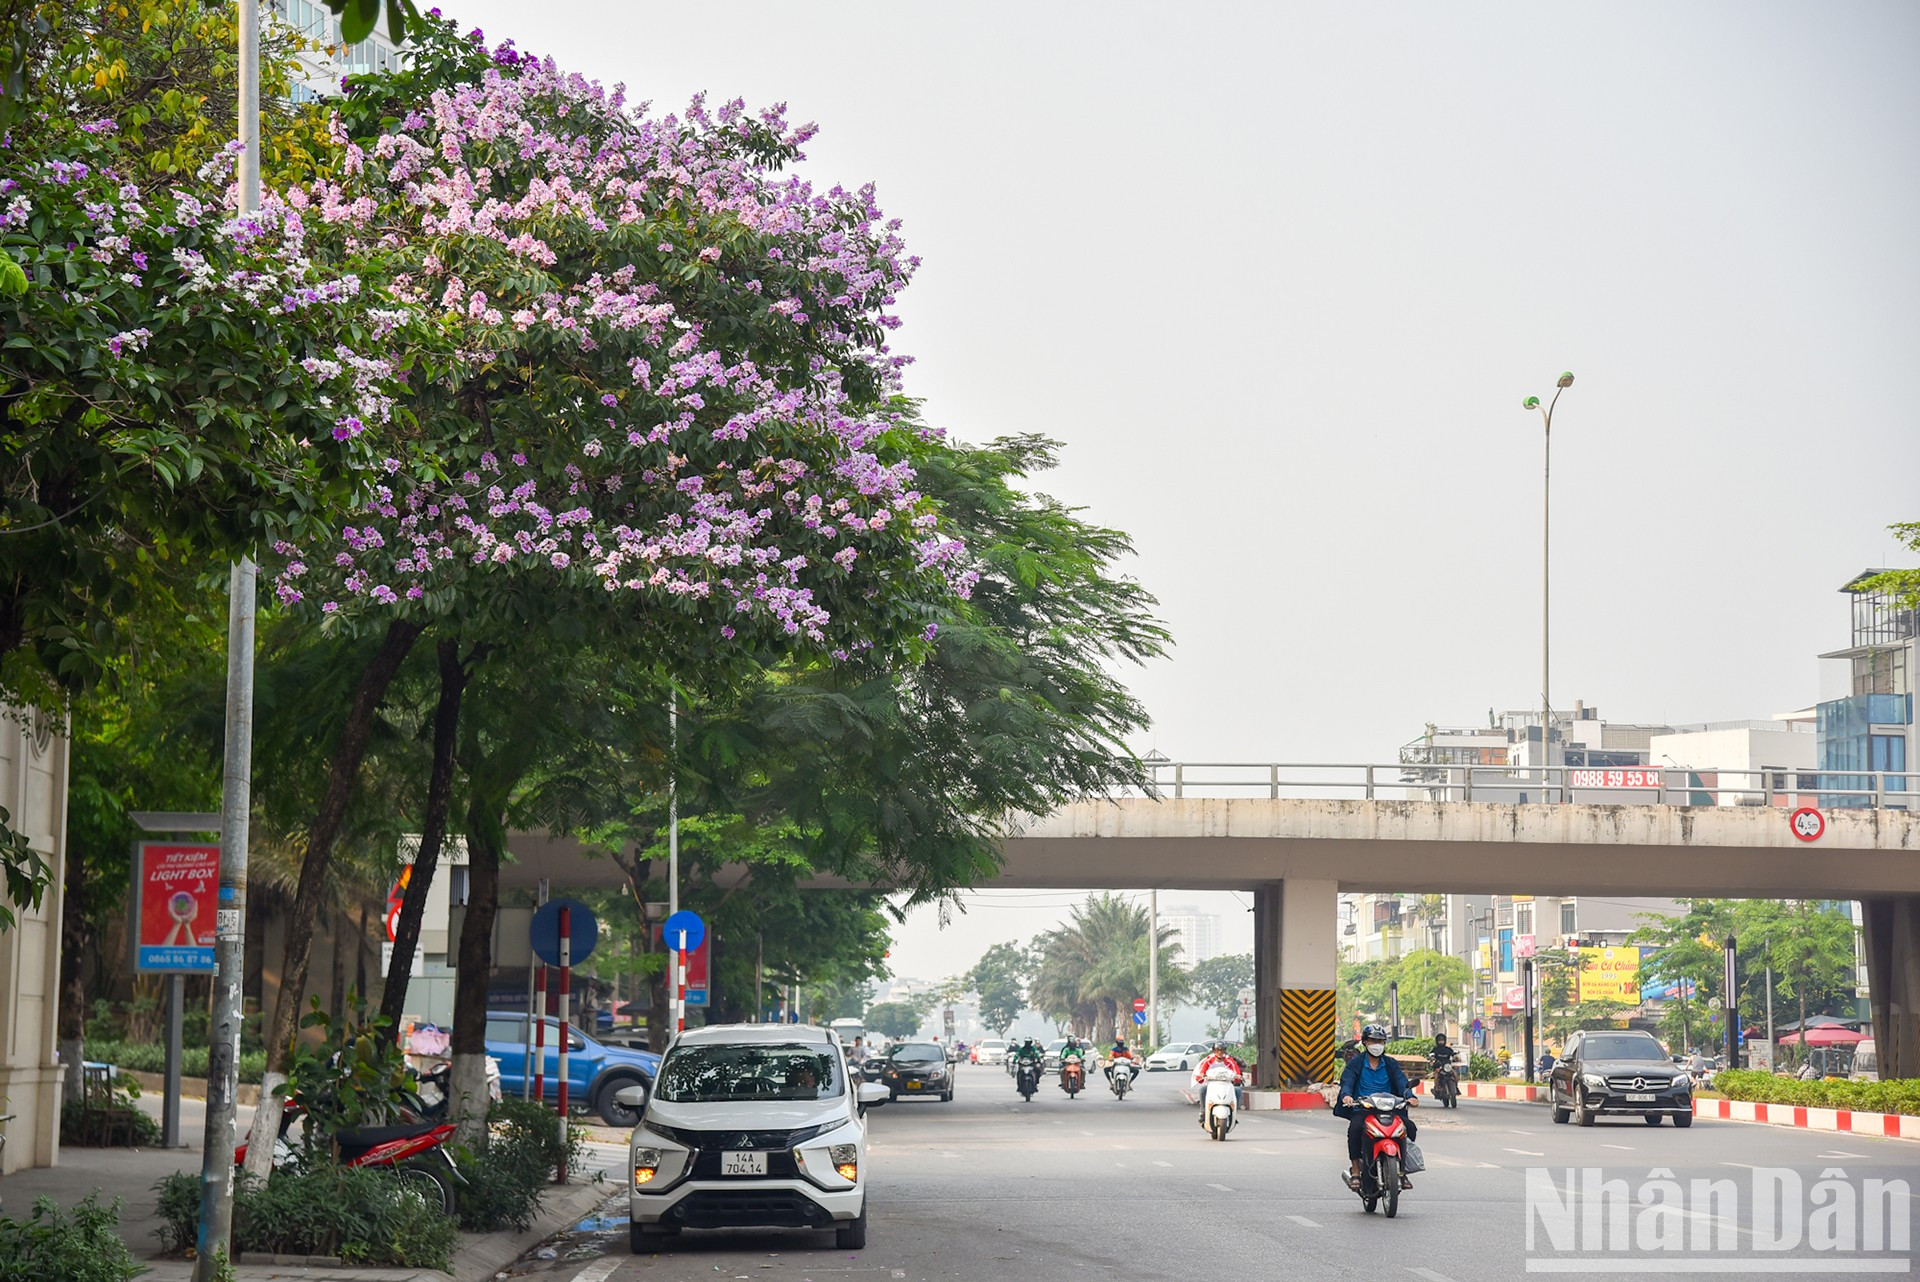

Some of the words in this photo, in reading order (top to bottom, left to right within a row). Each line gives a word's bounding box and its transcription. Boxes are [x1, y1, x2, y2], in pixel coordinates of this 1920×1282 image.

[1573, 770, 1604, 786] 0988
[1607, 770, 1623, 786] 59
[1627, 771, 1643, 786] 55
[150, 869, 188, 882] LIGHT
[188, 868, 215, 879] BOX
[736, 1153, 754, 1162] 14A
[726, 1164, 762, 1173] 704.14
